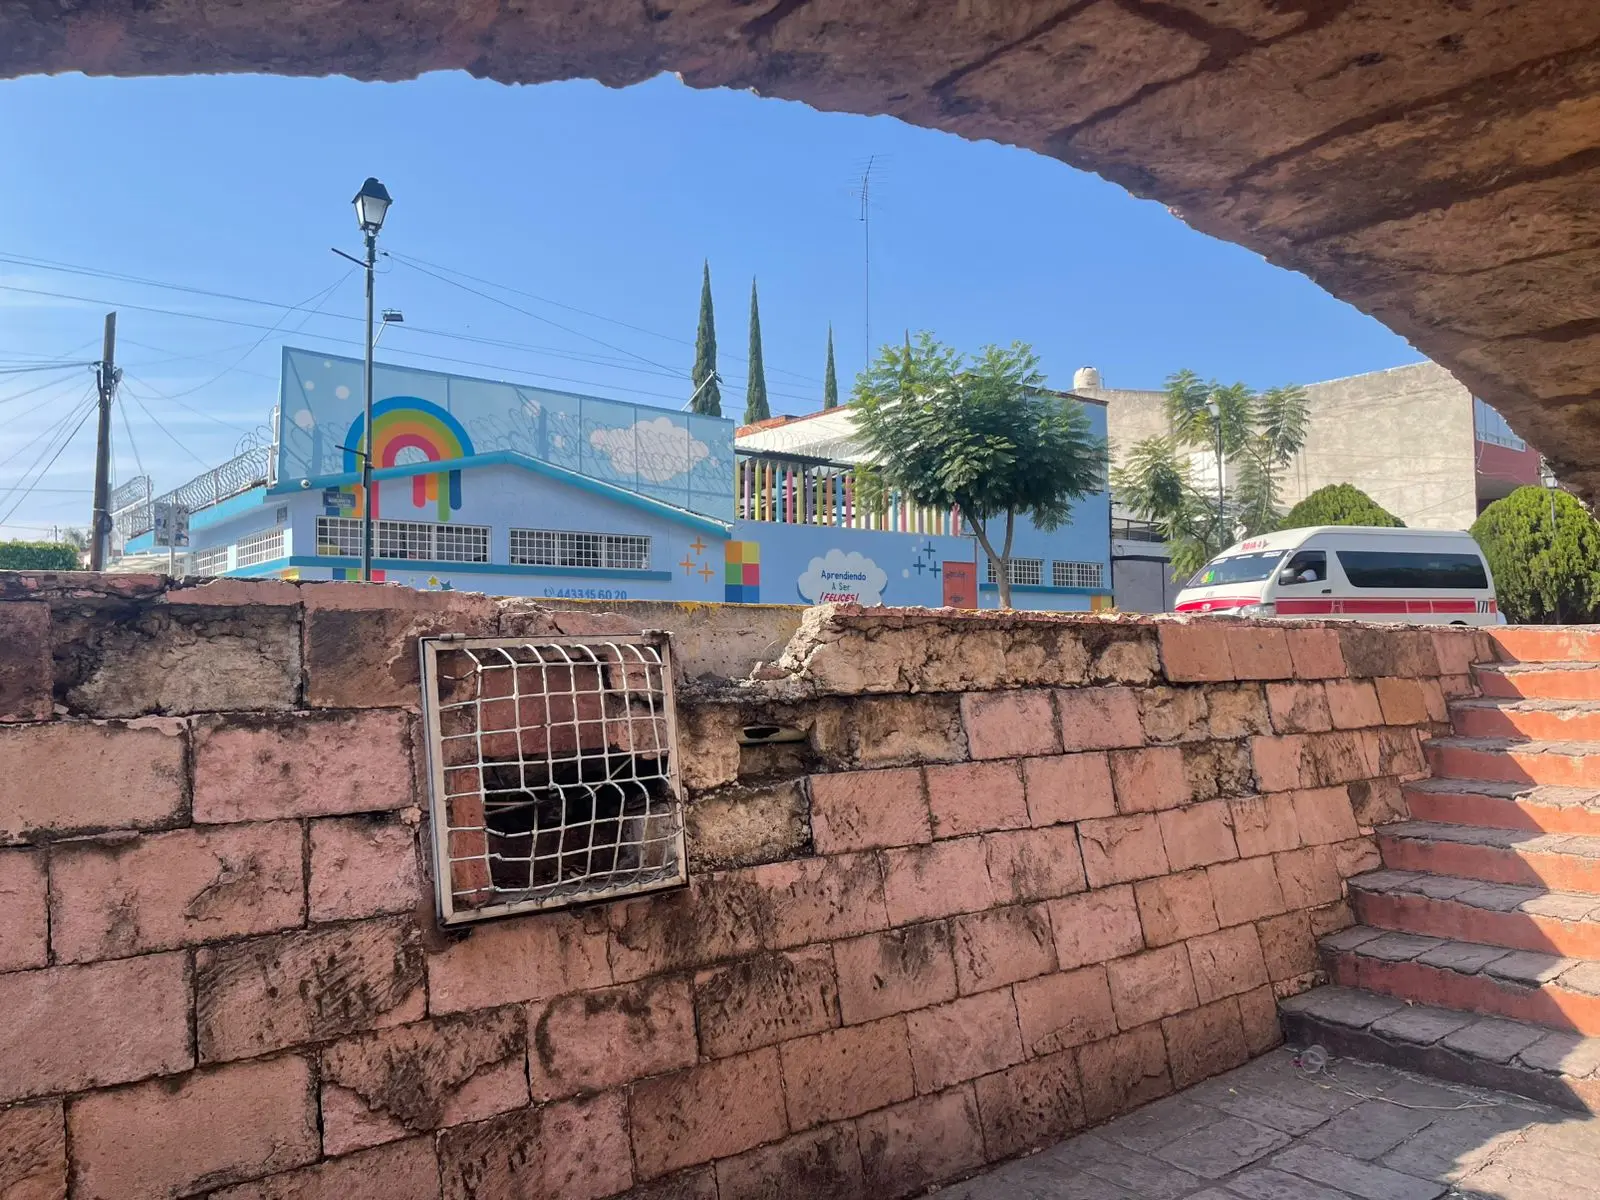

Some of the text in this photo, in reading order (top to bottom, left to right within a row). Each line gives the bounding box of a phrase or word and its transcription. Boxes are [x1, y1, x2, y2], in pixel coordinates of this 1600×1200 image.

[821, 570, 867, 581] Aprendiendo
[831, 582, 851, 591] A Ser
[598, 590, 612, 600] 60
[614, 590, 628, 600] 20
[1477, 600, 1489, 614] 171
